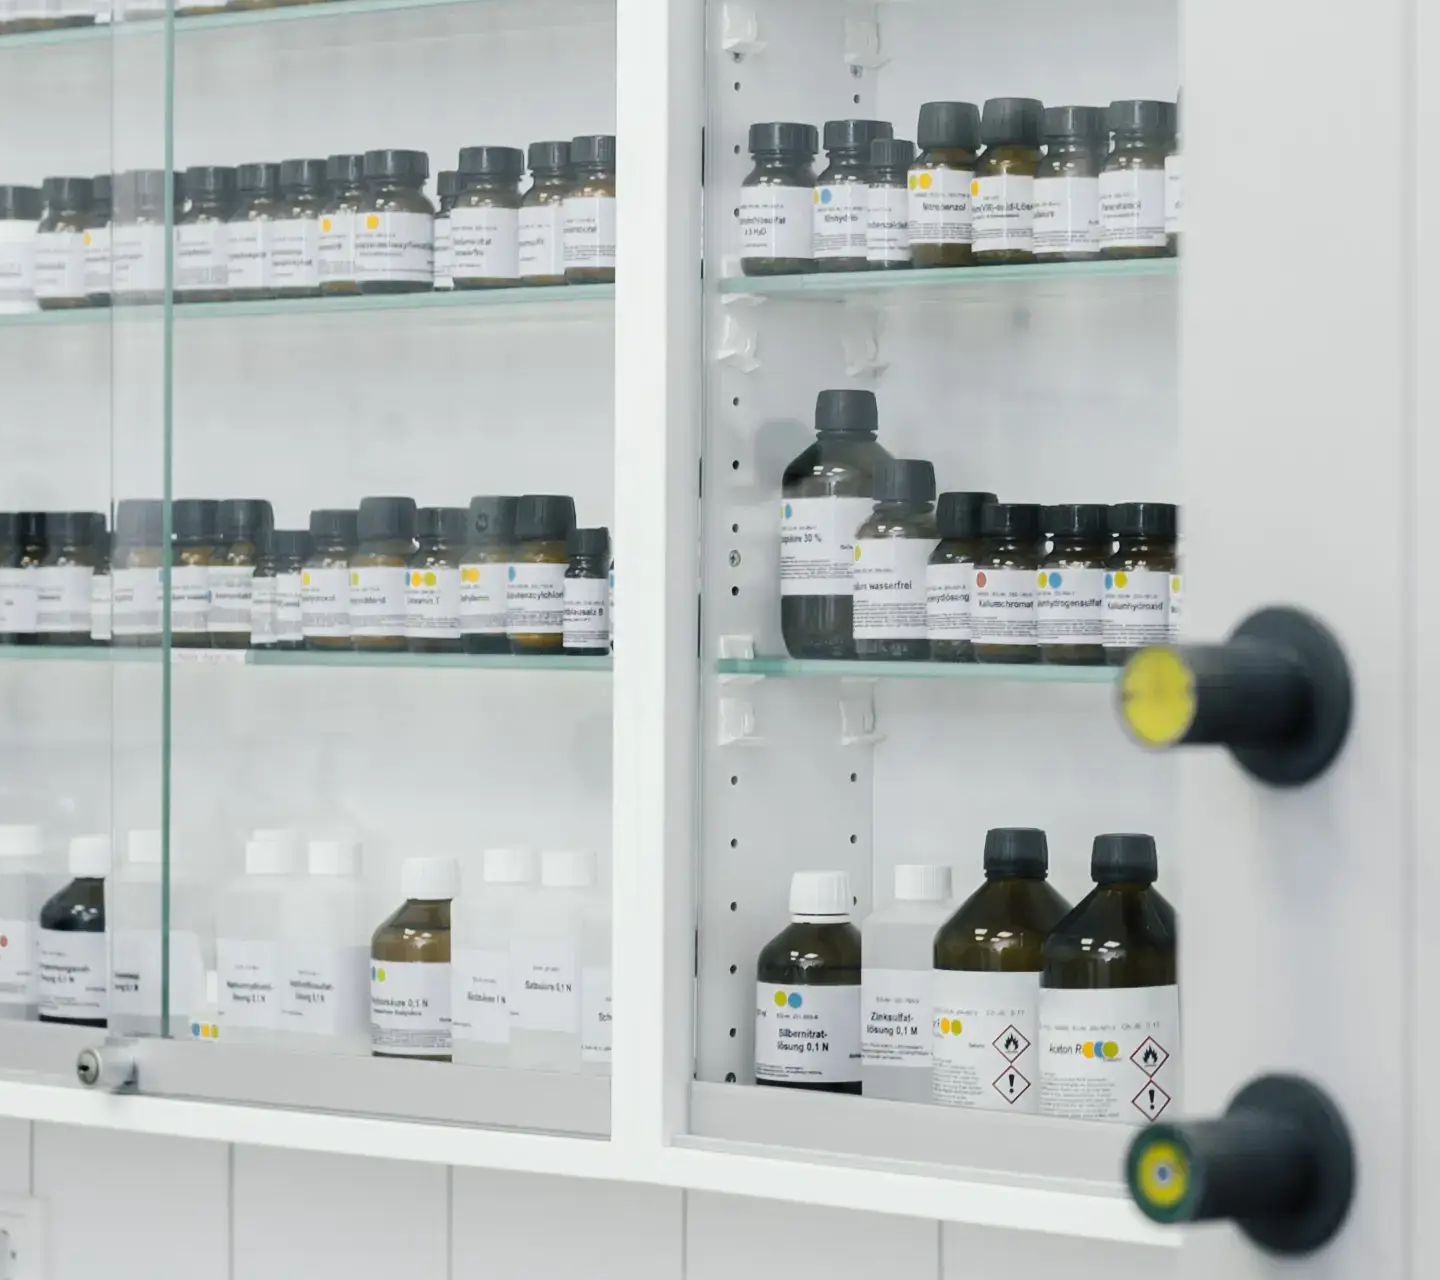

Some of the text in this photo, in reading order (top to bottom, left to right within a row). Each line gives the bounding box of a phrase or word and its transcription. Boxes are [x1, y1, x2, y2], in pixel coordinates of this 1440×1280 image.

[870, 1011, 914, 1023] Zinksulfat-
[778, 1028, 828, 1040] Silbernitrat-
[866, 1024, 919, 1037] lösung 0,1 M
[776, 1041, 830, 1053] lösung 0,1 N
